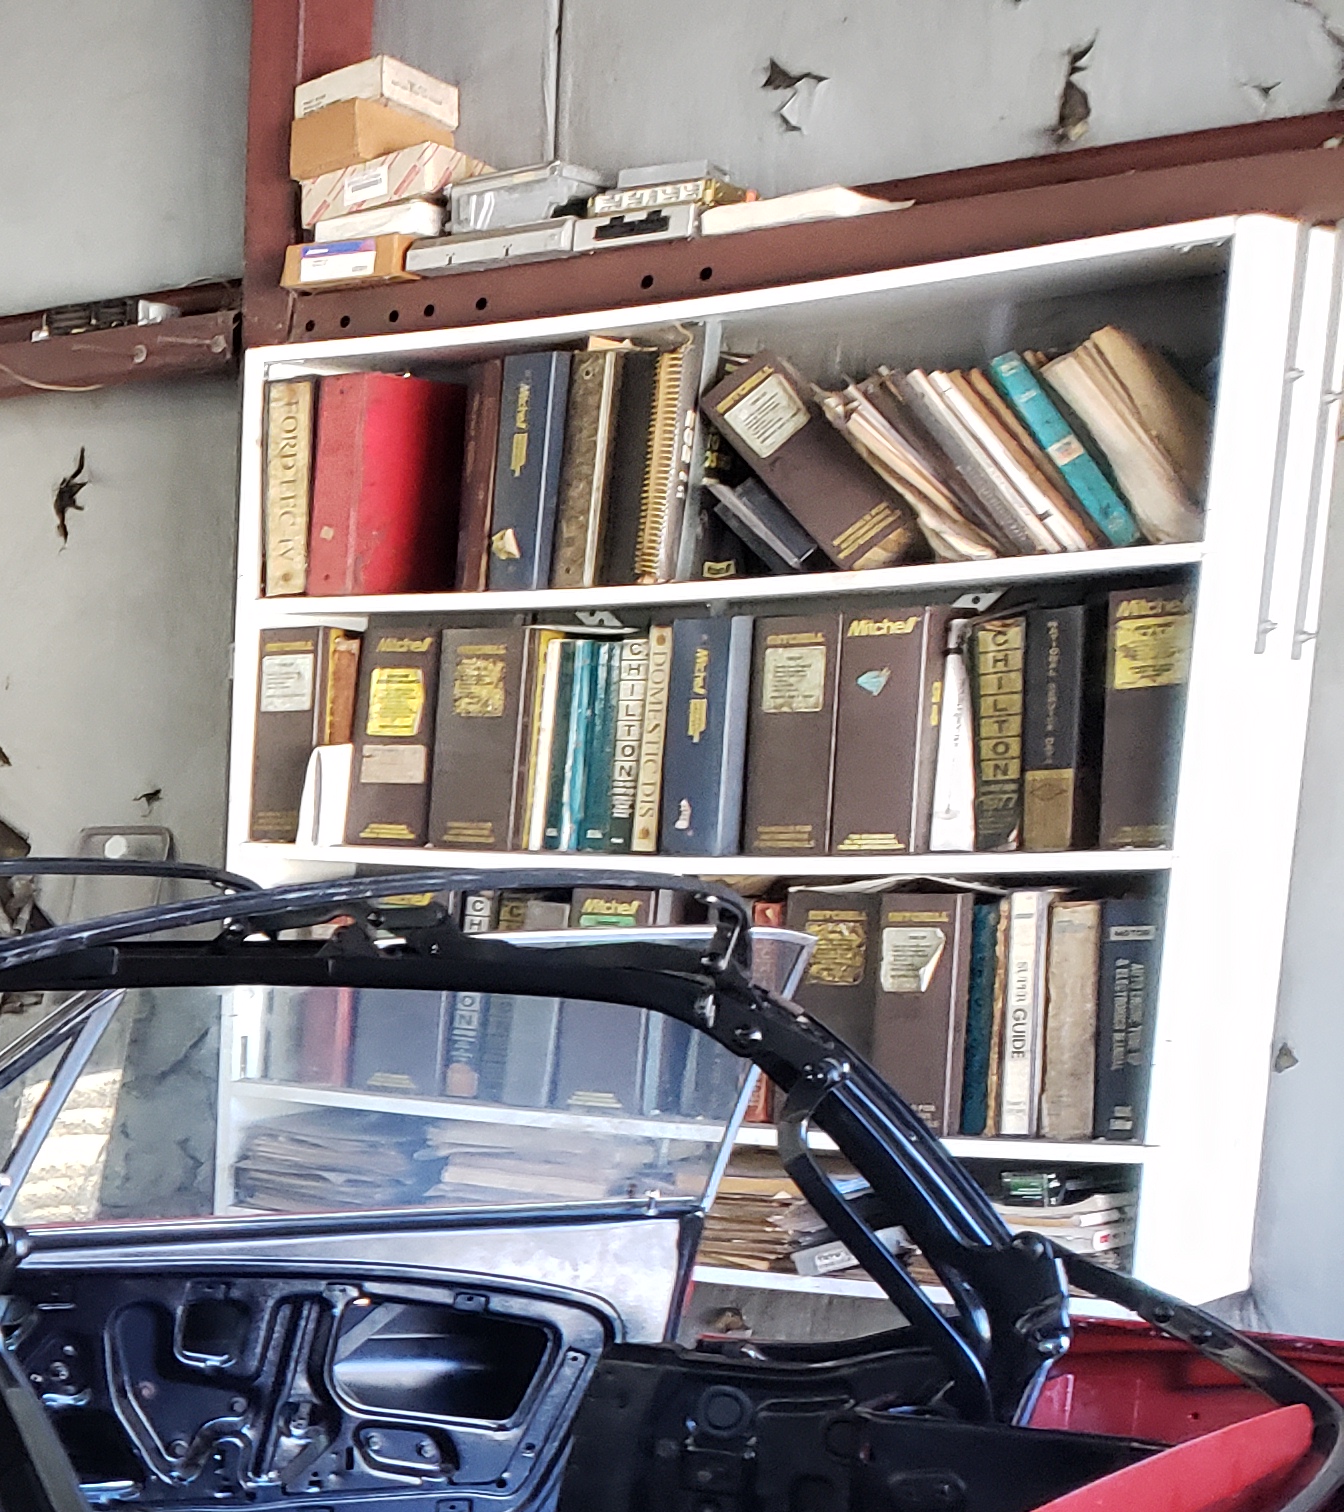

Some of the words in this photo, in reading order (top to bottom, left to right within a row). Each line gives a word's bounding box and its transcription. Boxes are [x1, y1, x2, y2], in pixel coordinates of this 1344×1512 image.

[275, 401, 299, 473] FORD
[847, 616, 919, 637] Mitchell
[617, 642, 642, 778] CHILTON
[643, 651, 668, 776] DOMESTIC
[989, 631, 1010, 777] CHILTON
[638, 782, 655, 818] DIS
[581, 898, 639, 914] Mitchell
[1011, 1008, 1028, 1059] GUIDE
